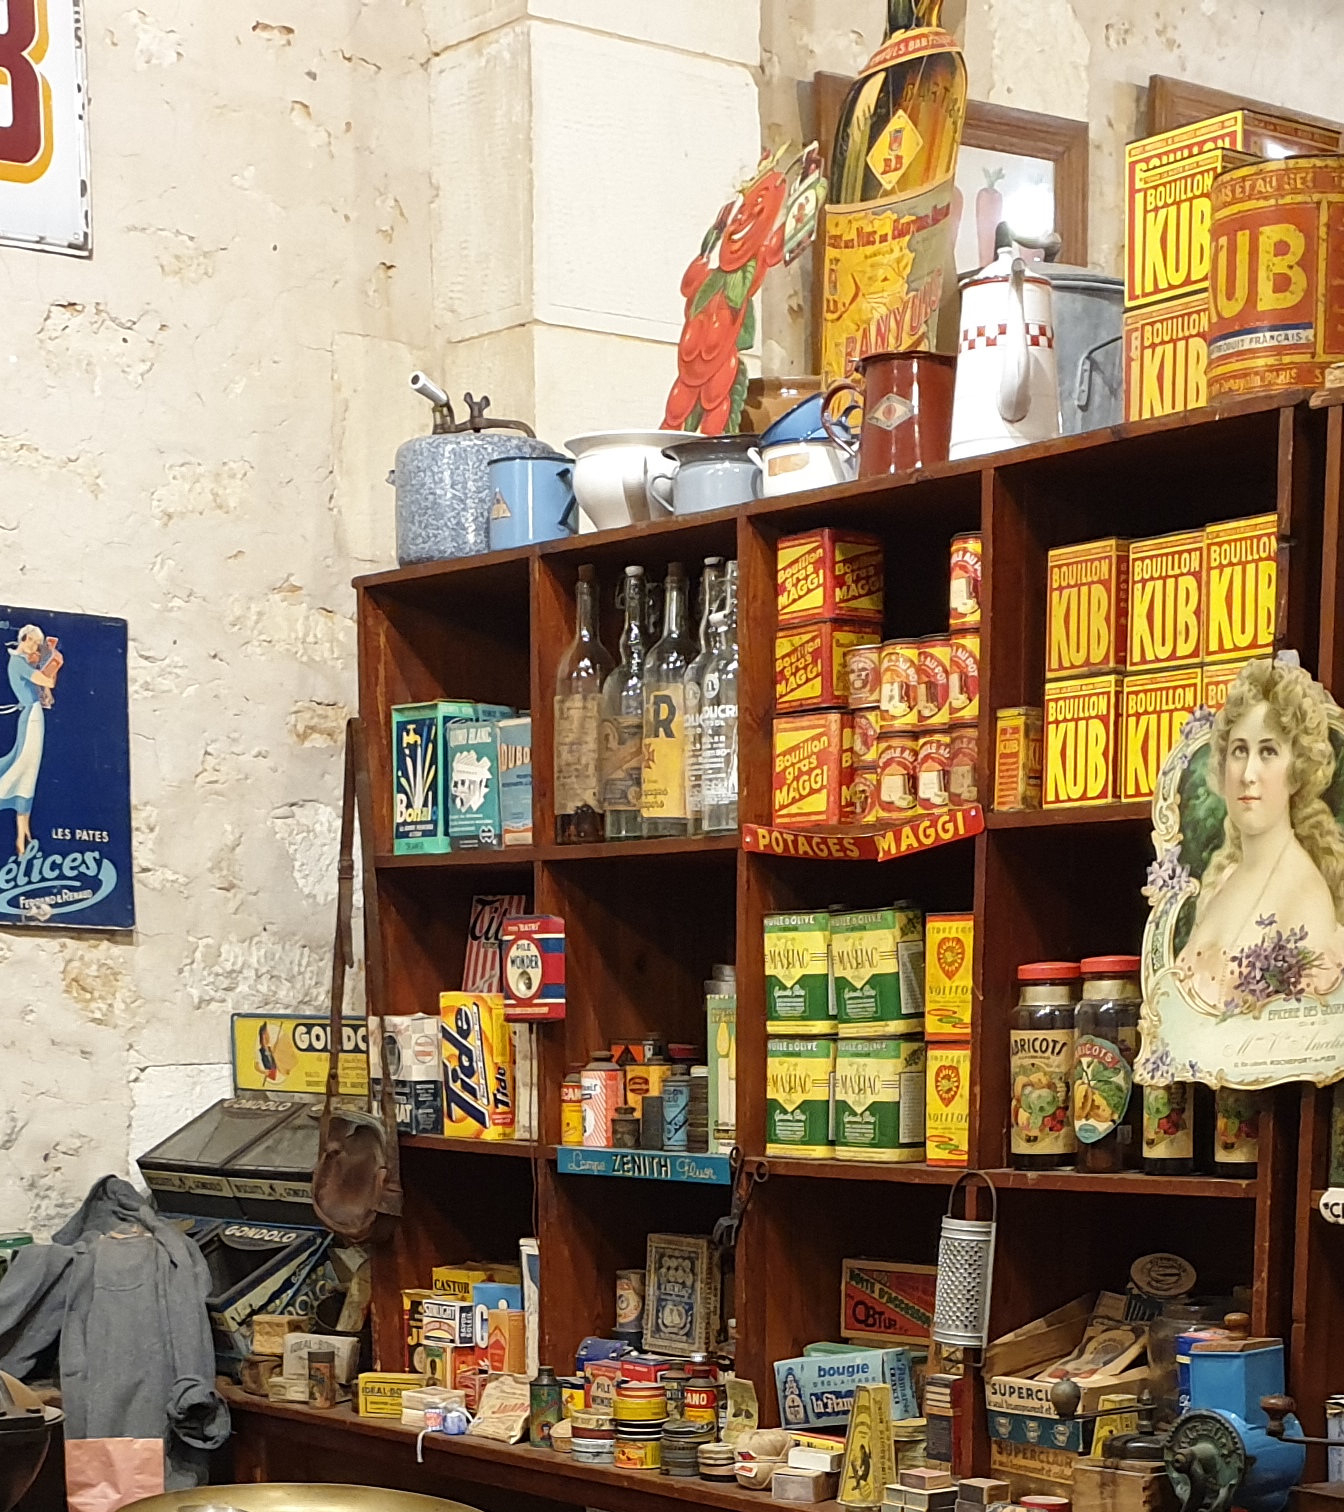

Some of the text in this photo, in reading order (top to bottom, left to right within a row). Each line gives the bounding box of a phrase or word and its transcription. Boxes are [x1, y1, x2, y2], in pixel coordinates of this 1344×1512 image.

[1146, 170, 1214, 202] BOUILLON
[1144, 309, 1209, 348] BOUILLON
[1133, 550, 1200, 581] BOUILLON
[1210, 535, 1278, 568] BOUILLON
[778, 569, 825, 606] MAGGI
[1052, 561, 1110, 585] BOUILLON
[1131, 576, 1198, 659] KUB
[1209, 561, 1277, 647] KUB
[1051, 582, 1108, 666] KUB
[775, 661, 823, 699] MAGGI
[1048, 697, 1108, 720] BOUILLON
[1128, 686, 1195, 714] BOUILLON
[774, 733, 830, 772] Bouillon
[1046, 719, 1107, 802] KUB
[775, 767, 829, 808] MAGGI
[785, 758, 819, 784] gras
[51, 828, 72, 841] LES
[757, 815, 967, 859] POTAGES MAGGI
[441, 1004, 490, 1129] Tide
[612, 1154, 672, 1178] ZENITH
[224, 1224, 298, 1243] GONDOLO
[434, 1279, 470, 1294] CASTOR
[817, 1362, 870, 1379] bougie
